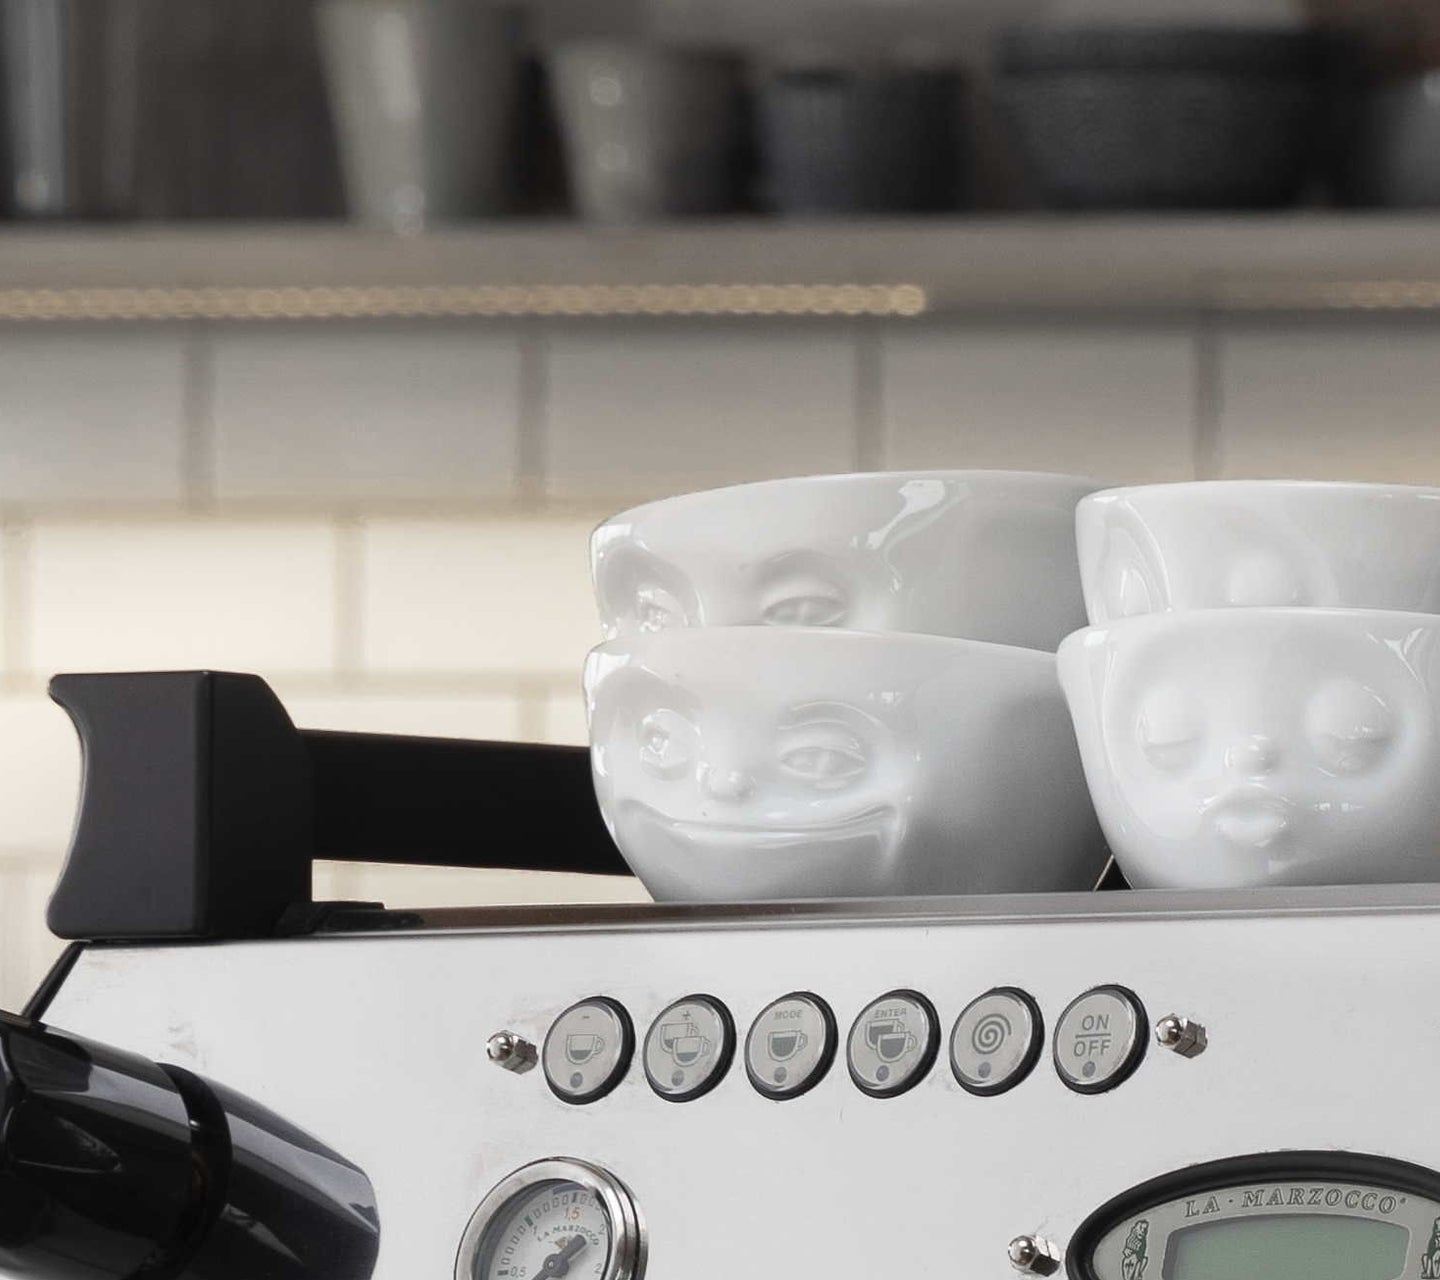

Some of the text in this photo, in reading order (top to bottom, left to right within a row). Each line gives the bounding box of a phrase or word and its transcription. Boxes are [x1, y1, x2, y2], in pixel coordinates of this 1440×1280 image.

[775, 1008, 803, 1020] MODE
[873, 1006, 908, 1019] ENTER
[1081, 1013, 1109, 1031] ON
[1073, 1039, 1112, 1057] OFF
[1184, 1195, 1220, 1218] LA
[511, 1266, 527, 1279] 0,5
